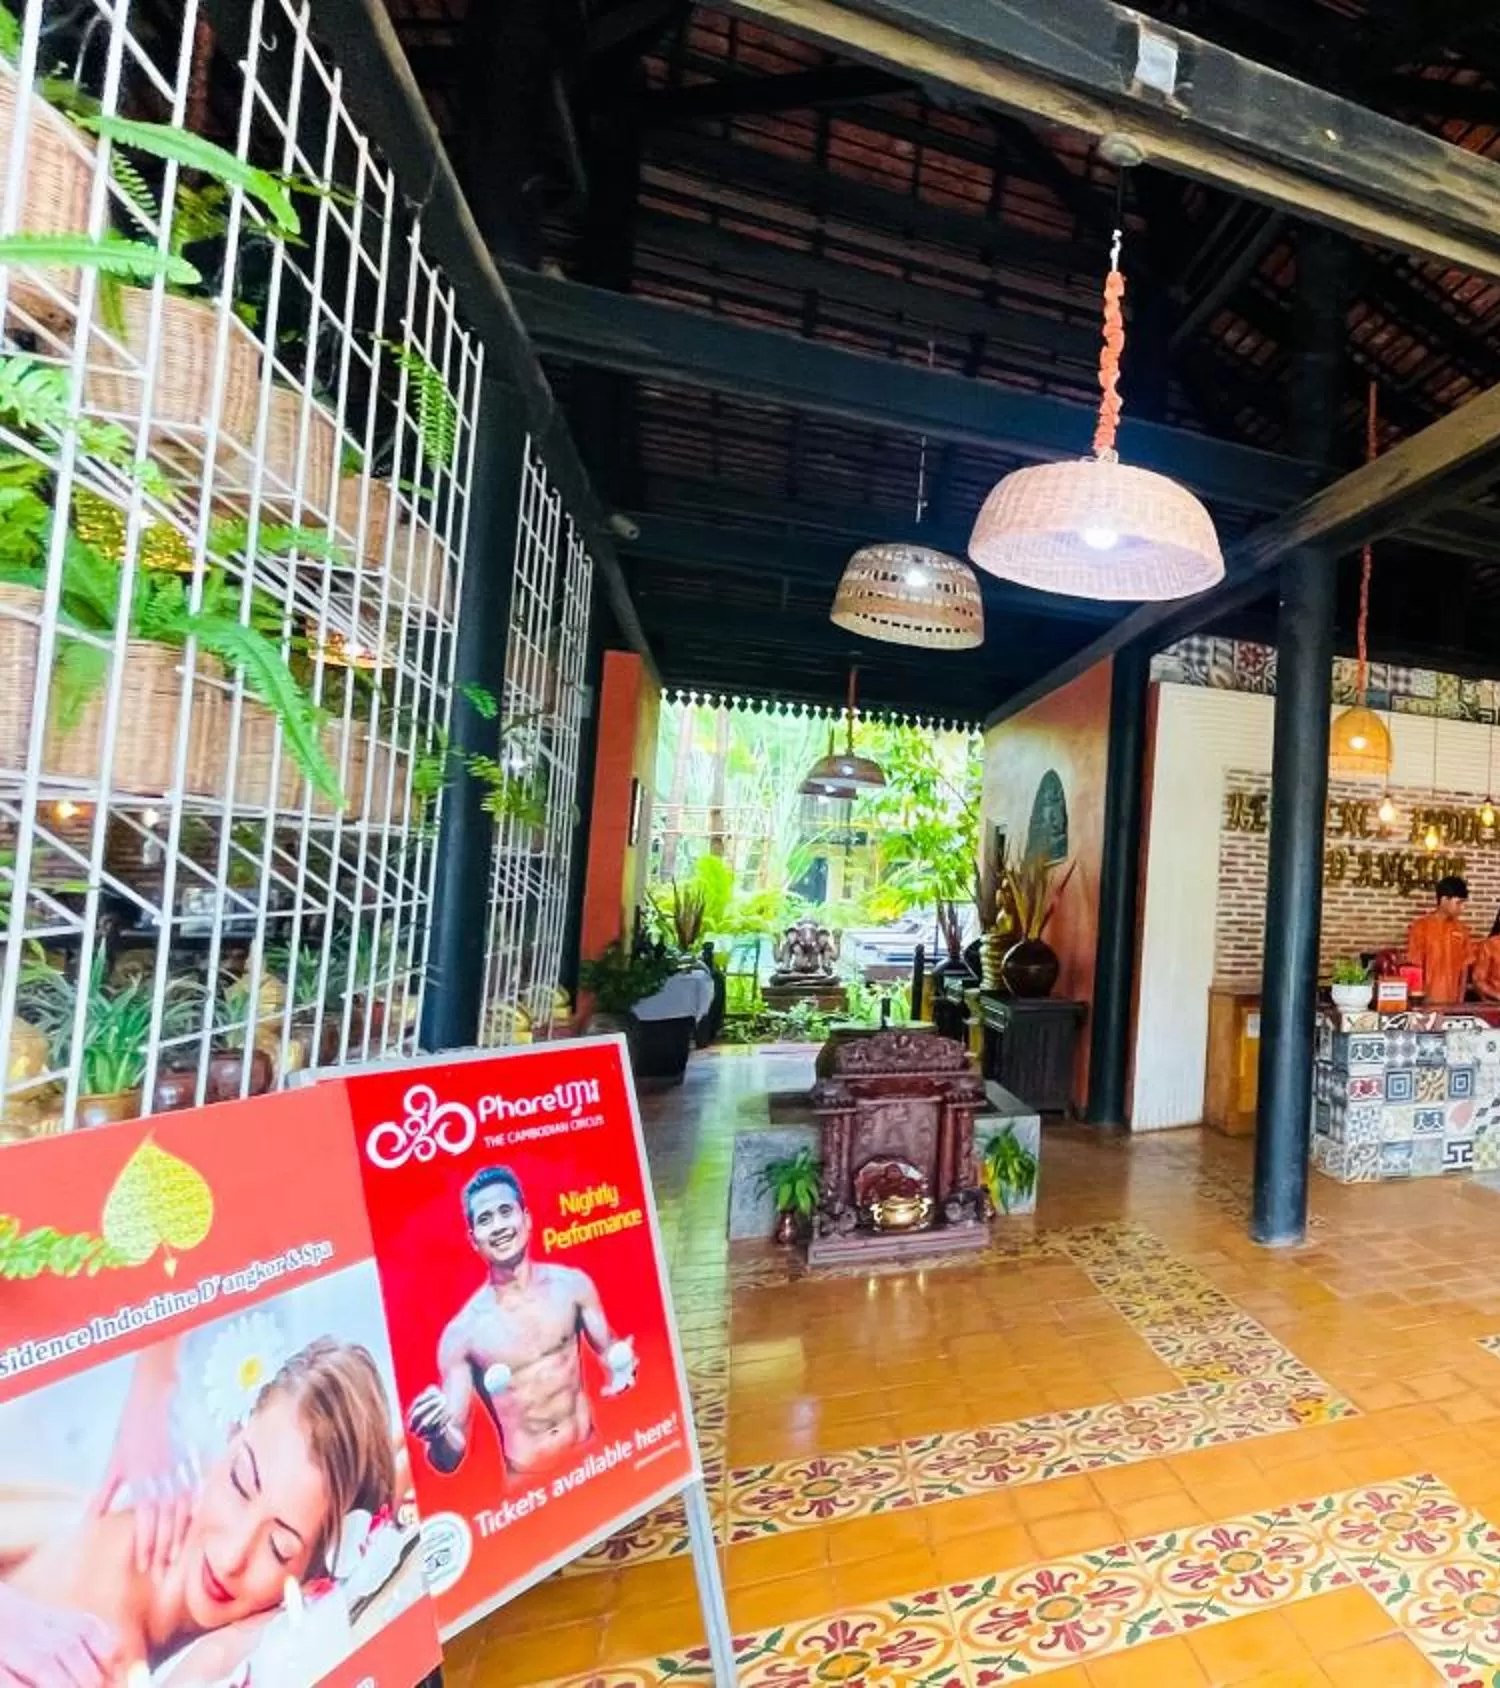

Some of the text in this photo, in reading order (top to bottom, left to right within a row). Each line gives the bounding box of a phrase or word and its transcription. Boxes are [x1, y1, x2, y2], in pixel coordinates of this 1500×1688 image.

[478, 1093, 556, 1123] Phare
[483, 1114, 606, 1149] THE CAMBODIAN CIRCUS
[559, 1182, 619, 1217] Nightly
[543, 1208, 643, 1255] Performance
[94, 1292, 197, 1339] Indochine
[474, 1487, 548, 1538] Tickets
[551, 1440, 633, 1497] available
[634, 1412, 679, 1451] here!
